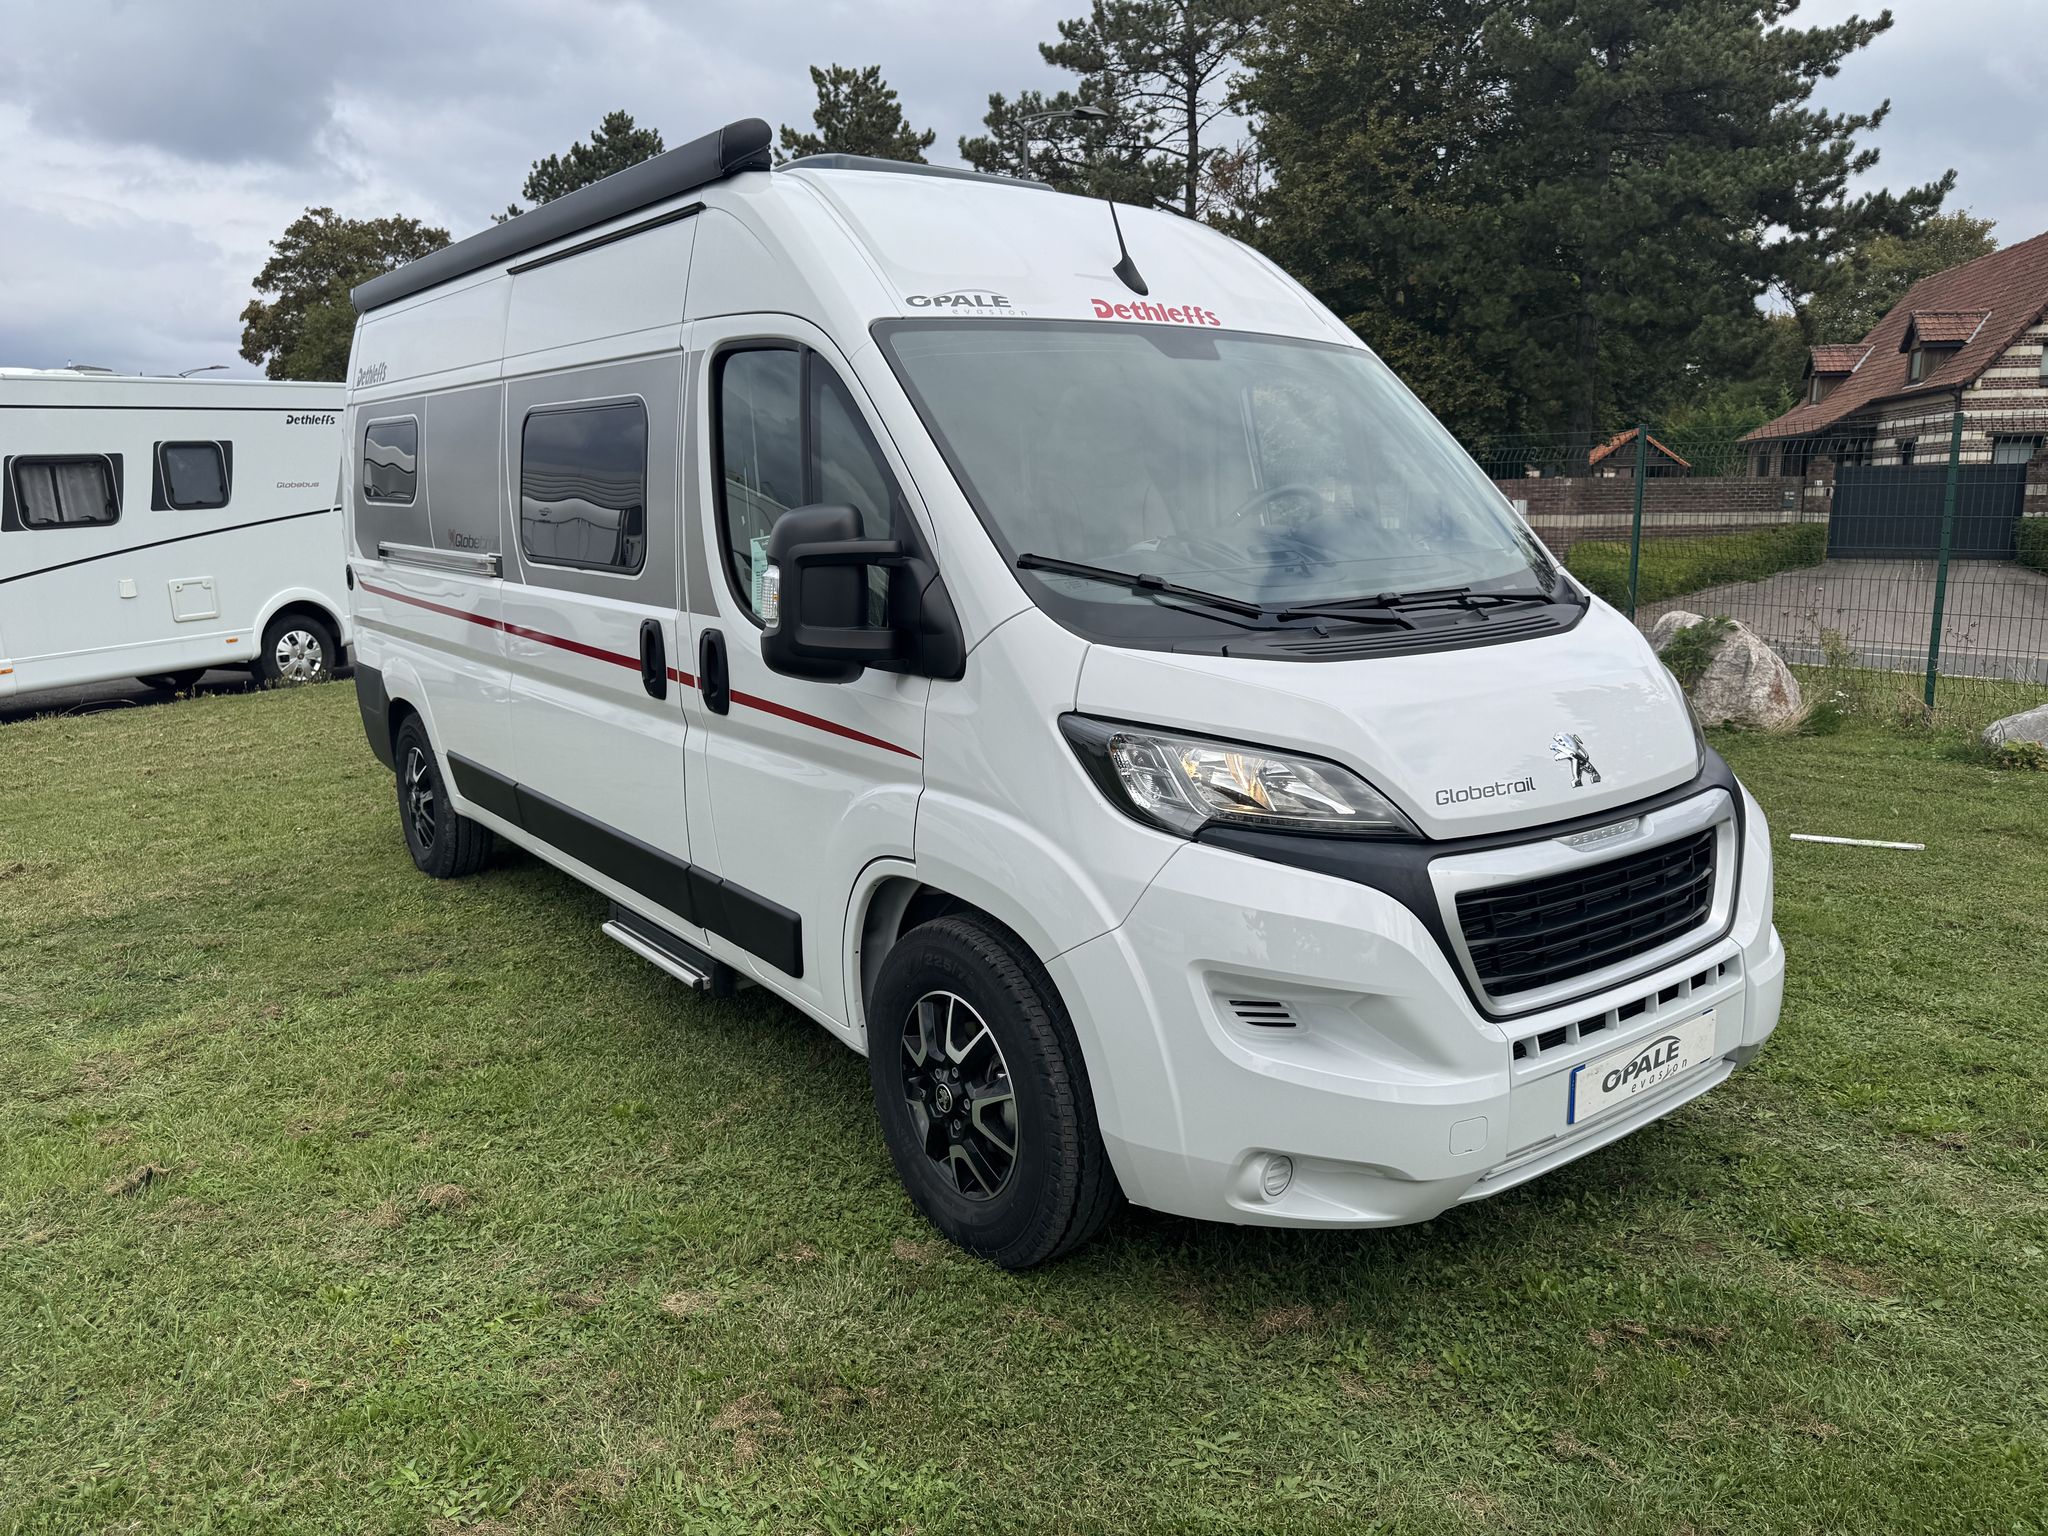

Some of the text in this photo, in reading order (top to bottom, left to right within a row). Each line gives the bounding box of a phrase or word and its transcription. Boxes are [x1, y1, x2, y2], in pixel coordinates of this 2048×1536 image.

[905, 294, 1012, 308] OPALE
[1091, 298, 1221, 326] Dethleffs
[357, 362, 387, 387] Dethleffs
[286, 414, 335, 425] Dethleffs
[1435, 776, 1537, 806] Globetrail
[1601, 1039, 1681, 1094] OPALE
